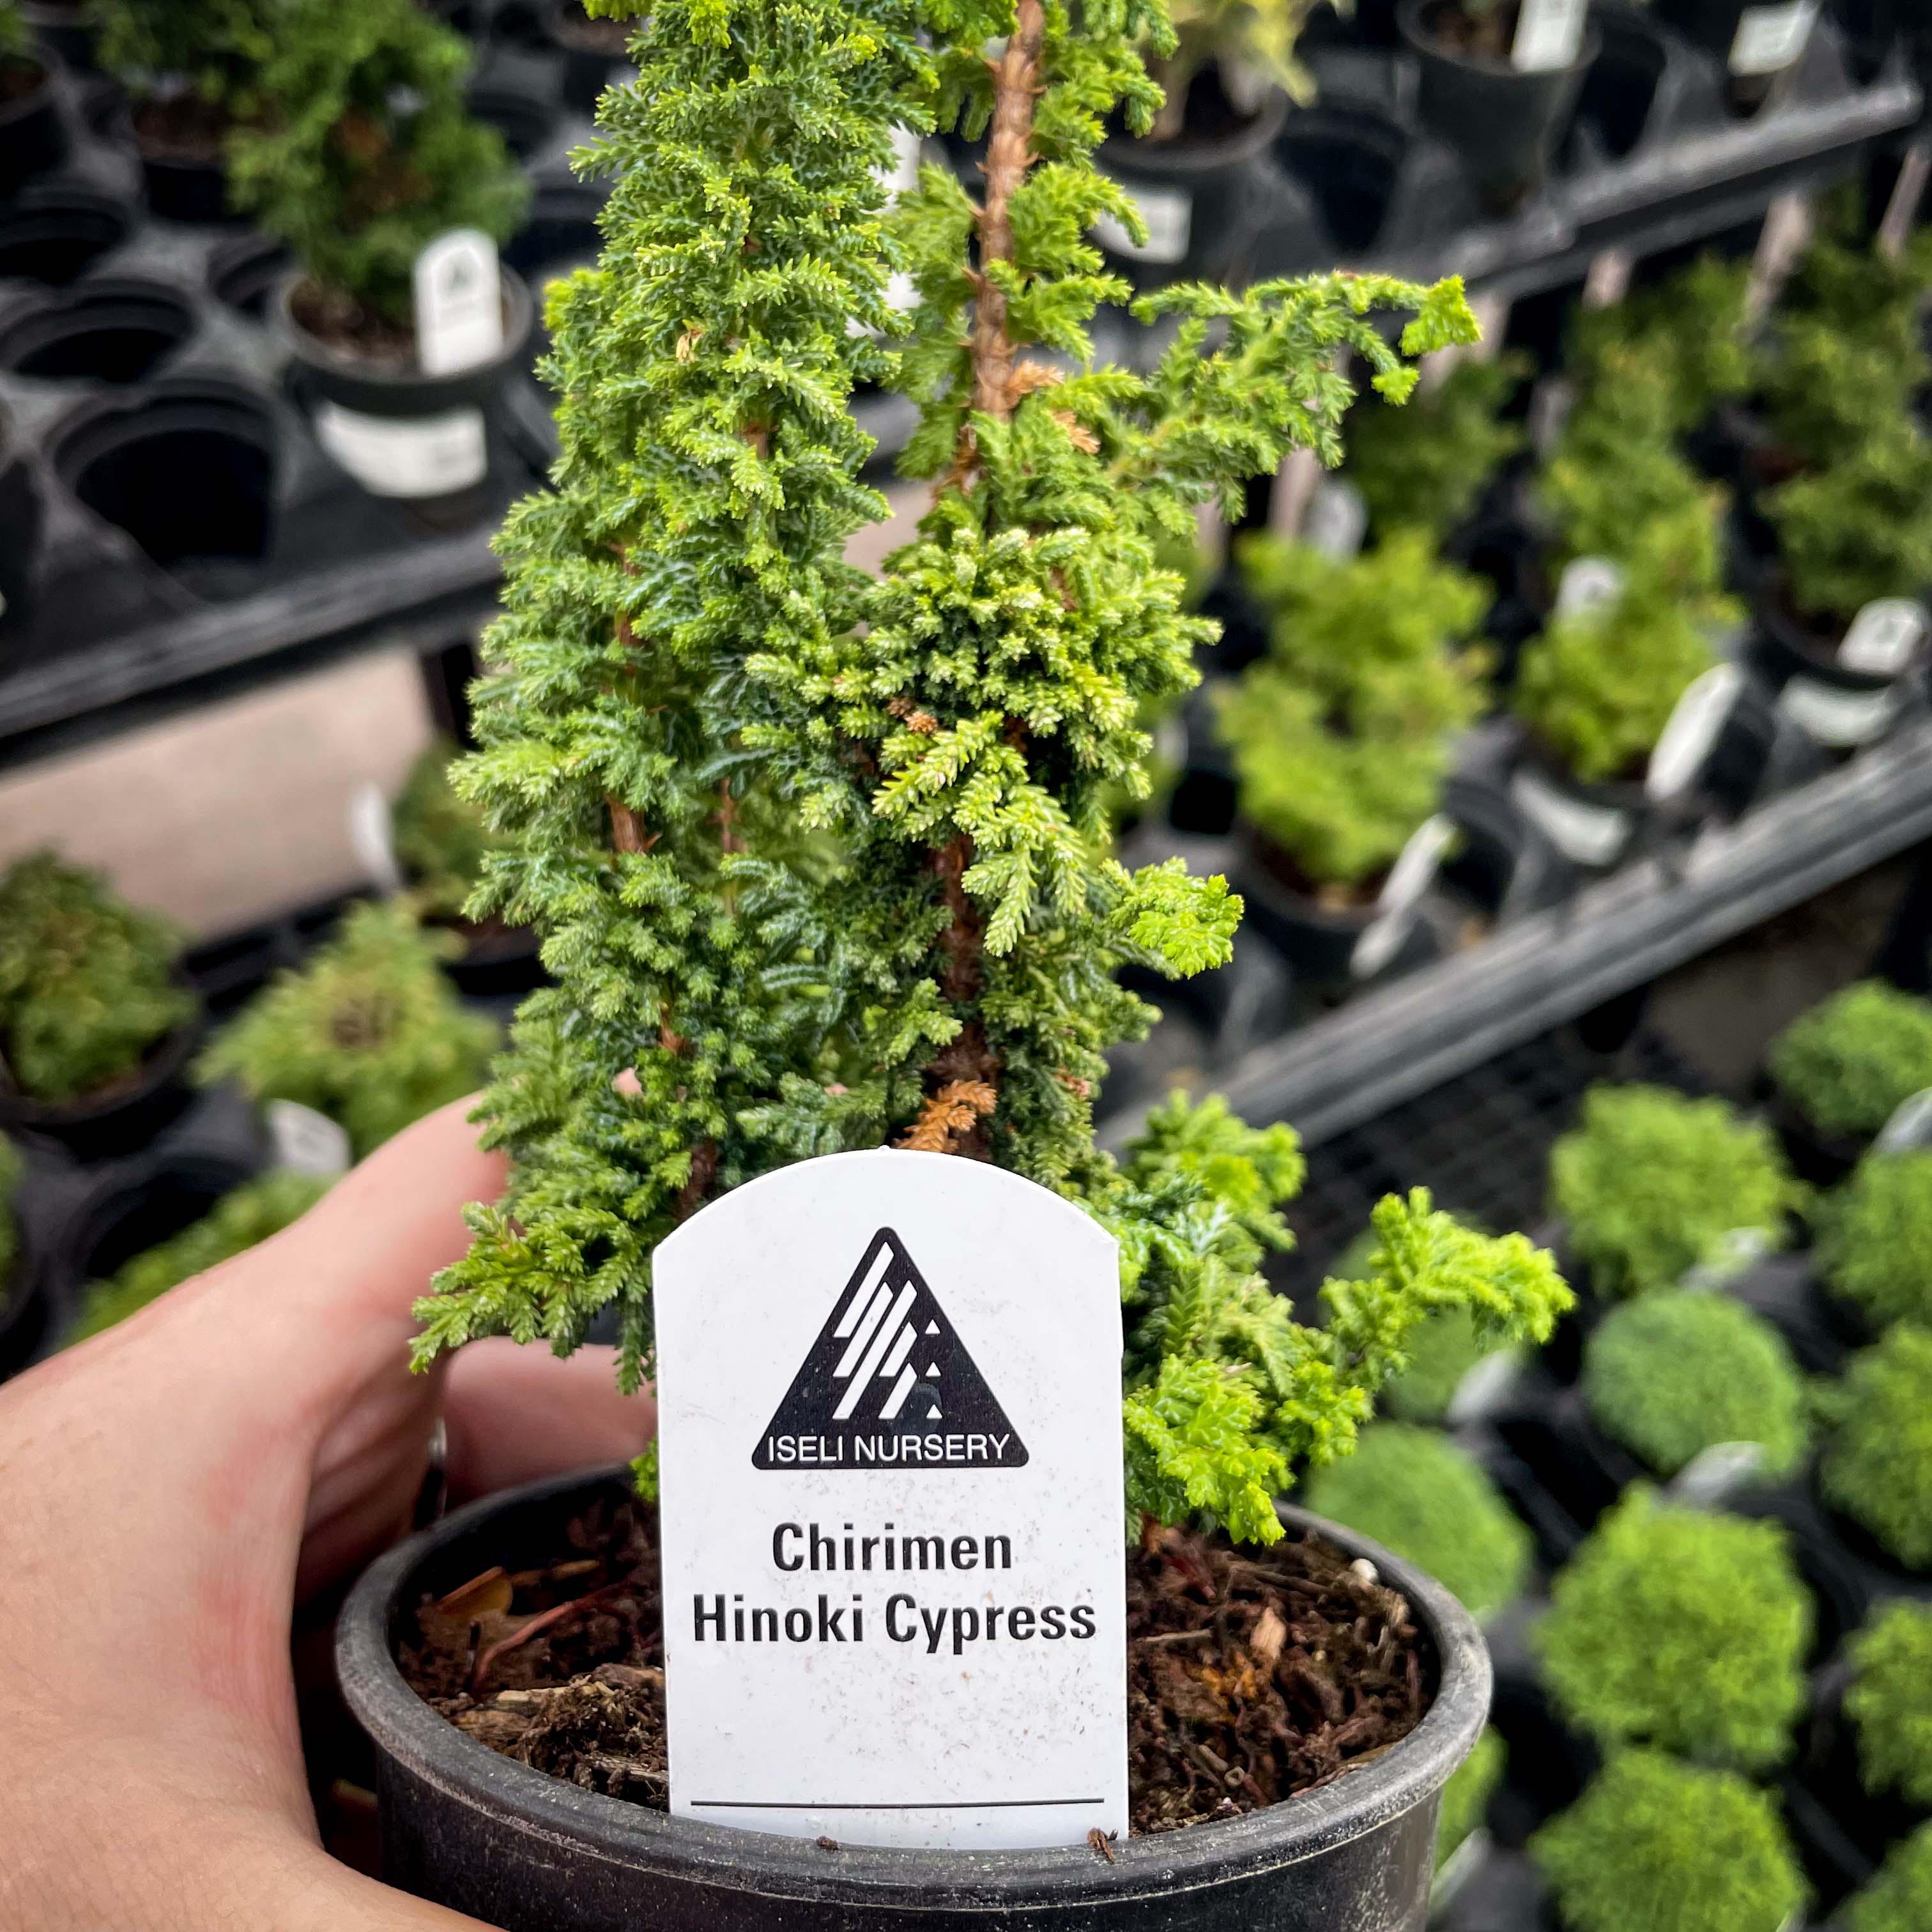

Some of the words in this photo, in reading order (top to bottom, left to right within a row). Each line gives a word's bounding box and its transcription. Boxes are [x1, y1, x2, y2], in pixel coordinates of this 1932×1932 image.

[769, 1435, 844, 1462] ISELI
[854, 1433, 1011, 1462] NURSERY
[772, 1522, 1013, 1572] Chirimen
[693, 1593, 863, 1643] Hinoki
[885, 1593, 1097, 1655] Cypress
